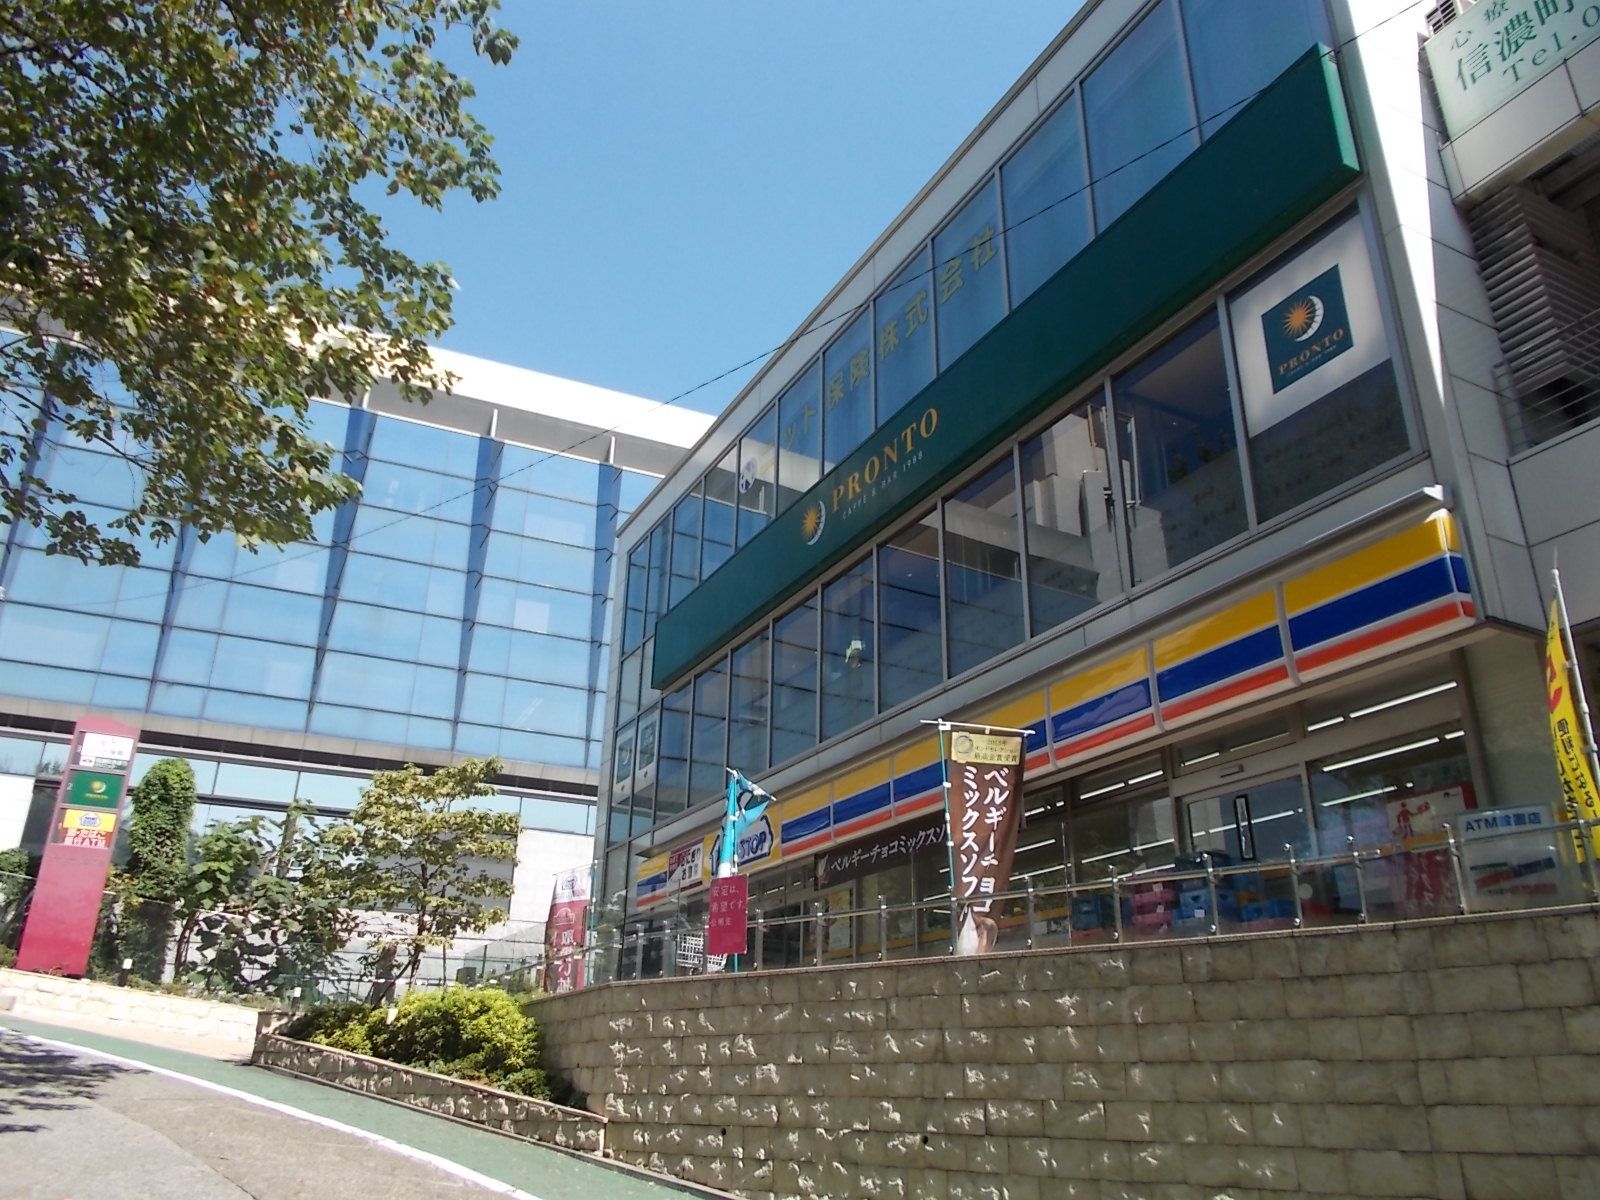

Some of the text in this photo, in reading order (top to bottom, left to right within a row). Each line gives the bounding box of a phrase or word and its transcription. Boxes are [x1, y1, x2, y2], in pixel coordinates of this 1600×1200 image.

[1279, 328, 1344, 375] PRONTO
[832, 407, 938, 513] PRONTO
[66, 782, 74, 791] 2
[738, 830, 768, 860] STOP
[972, 766, 1010, 914] ベルギーチョコ
